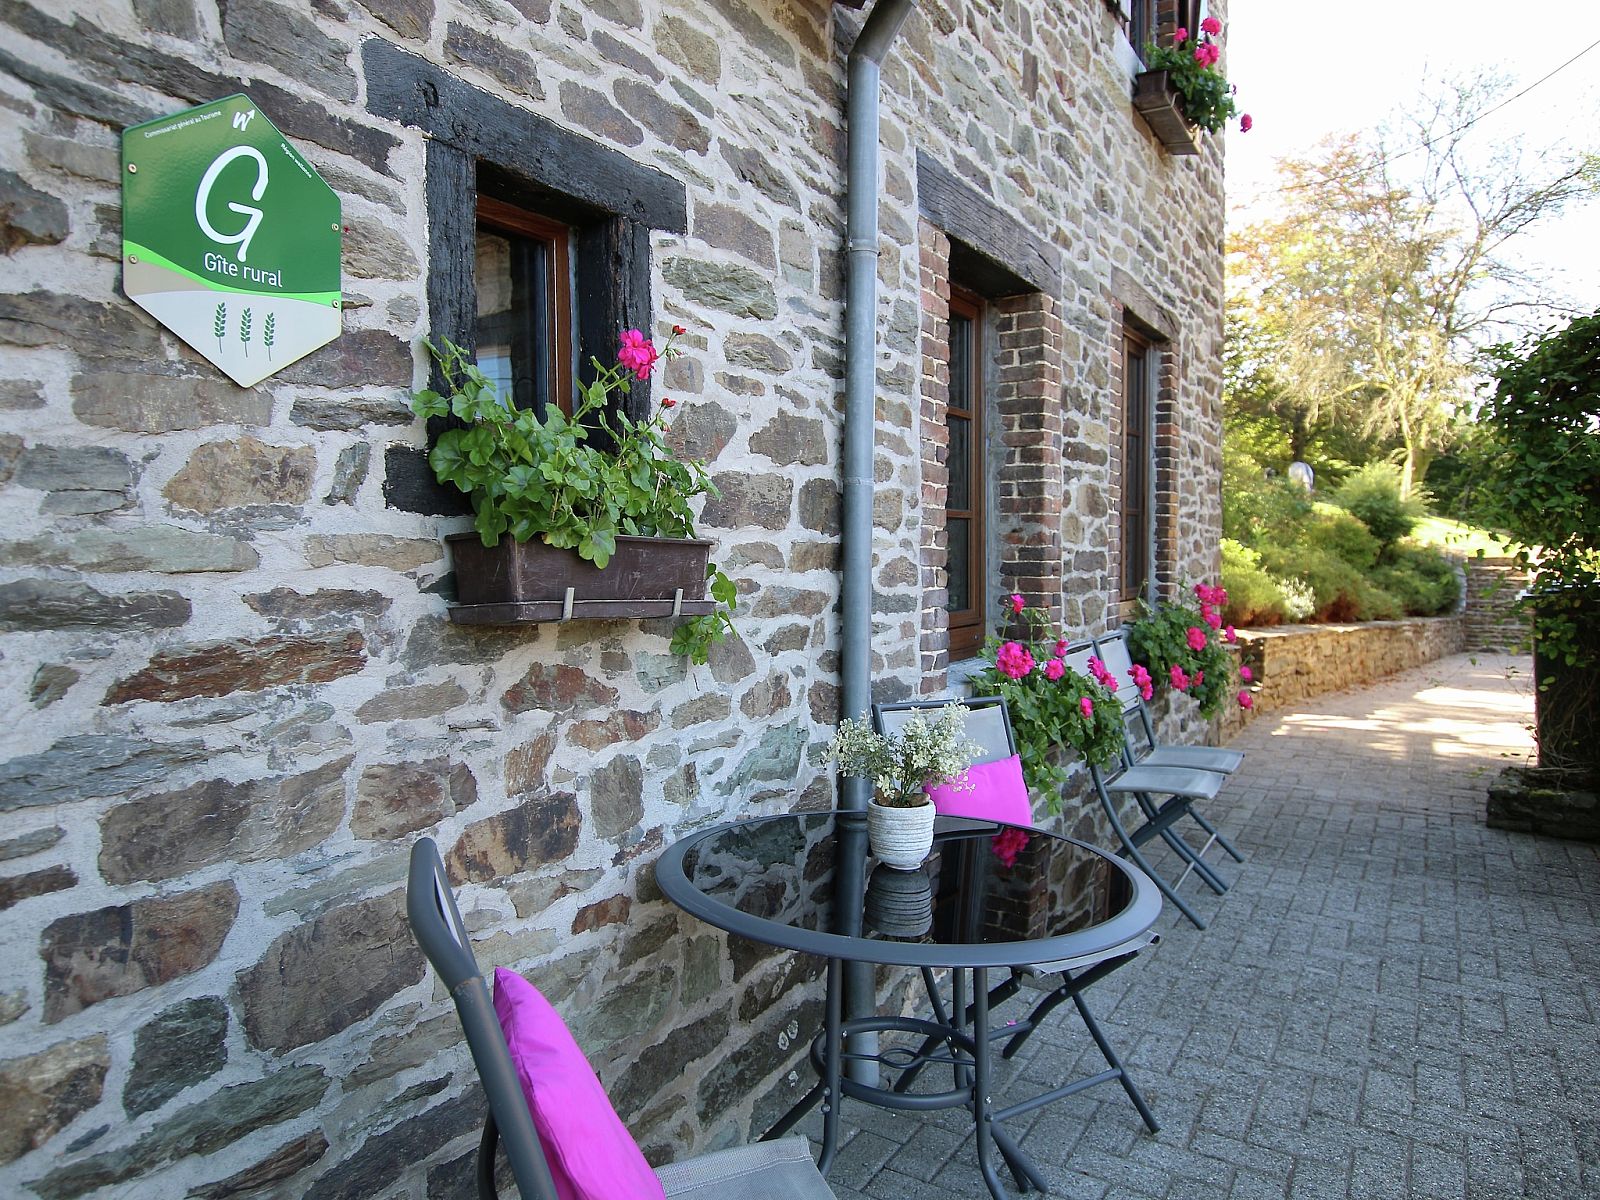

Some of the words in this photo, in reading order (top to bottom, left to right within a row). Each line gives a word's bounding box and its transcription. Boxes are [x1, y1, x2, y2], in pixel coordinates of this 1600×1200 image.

[195, 145, 269, 263] G
[204, 252, 239, 277] Gîte
[243, 266, 283, 288] rural
